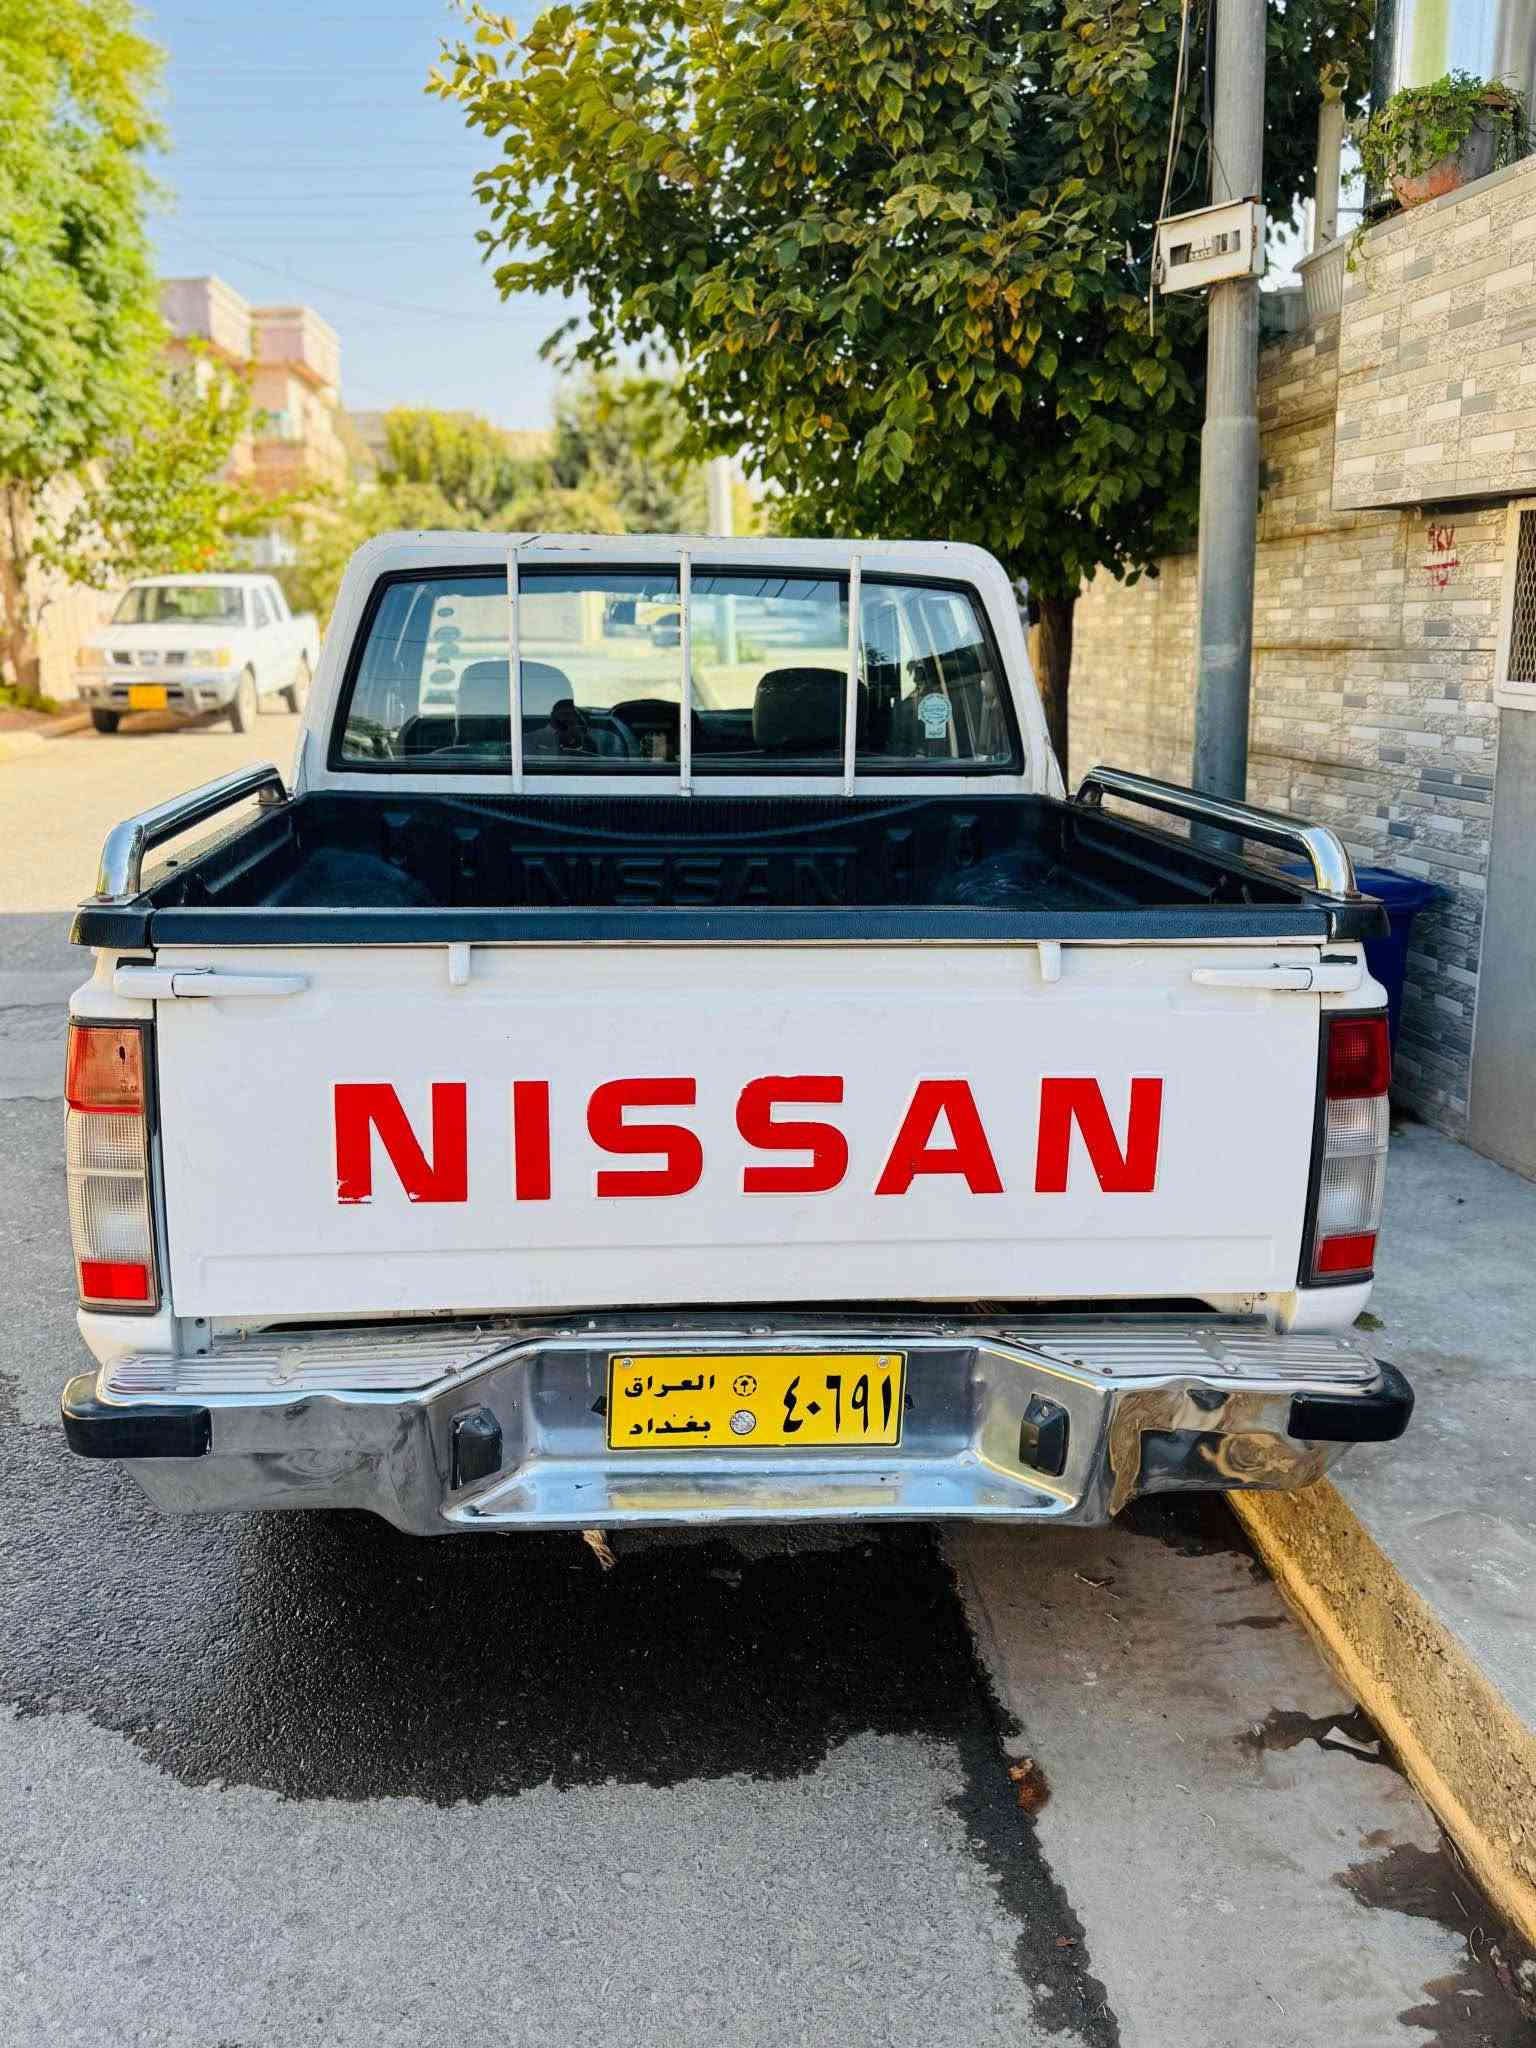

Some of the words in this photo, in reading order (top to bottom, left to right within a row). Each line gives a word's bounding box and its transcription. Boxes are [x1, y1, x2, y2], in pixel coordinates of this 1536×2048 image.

[523, 857, 850, 904] NISSAN
[333, 1075, 1164, 1204] NISSAN
[624, 1374, 716, 1398] العراق
[782, 1374, 892, 1434] ٤٠٦٩١
[629, 1414, 712, 1439] بغداد
